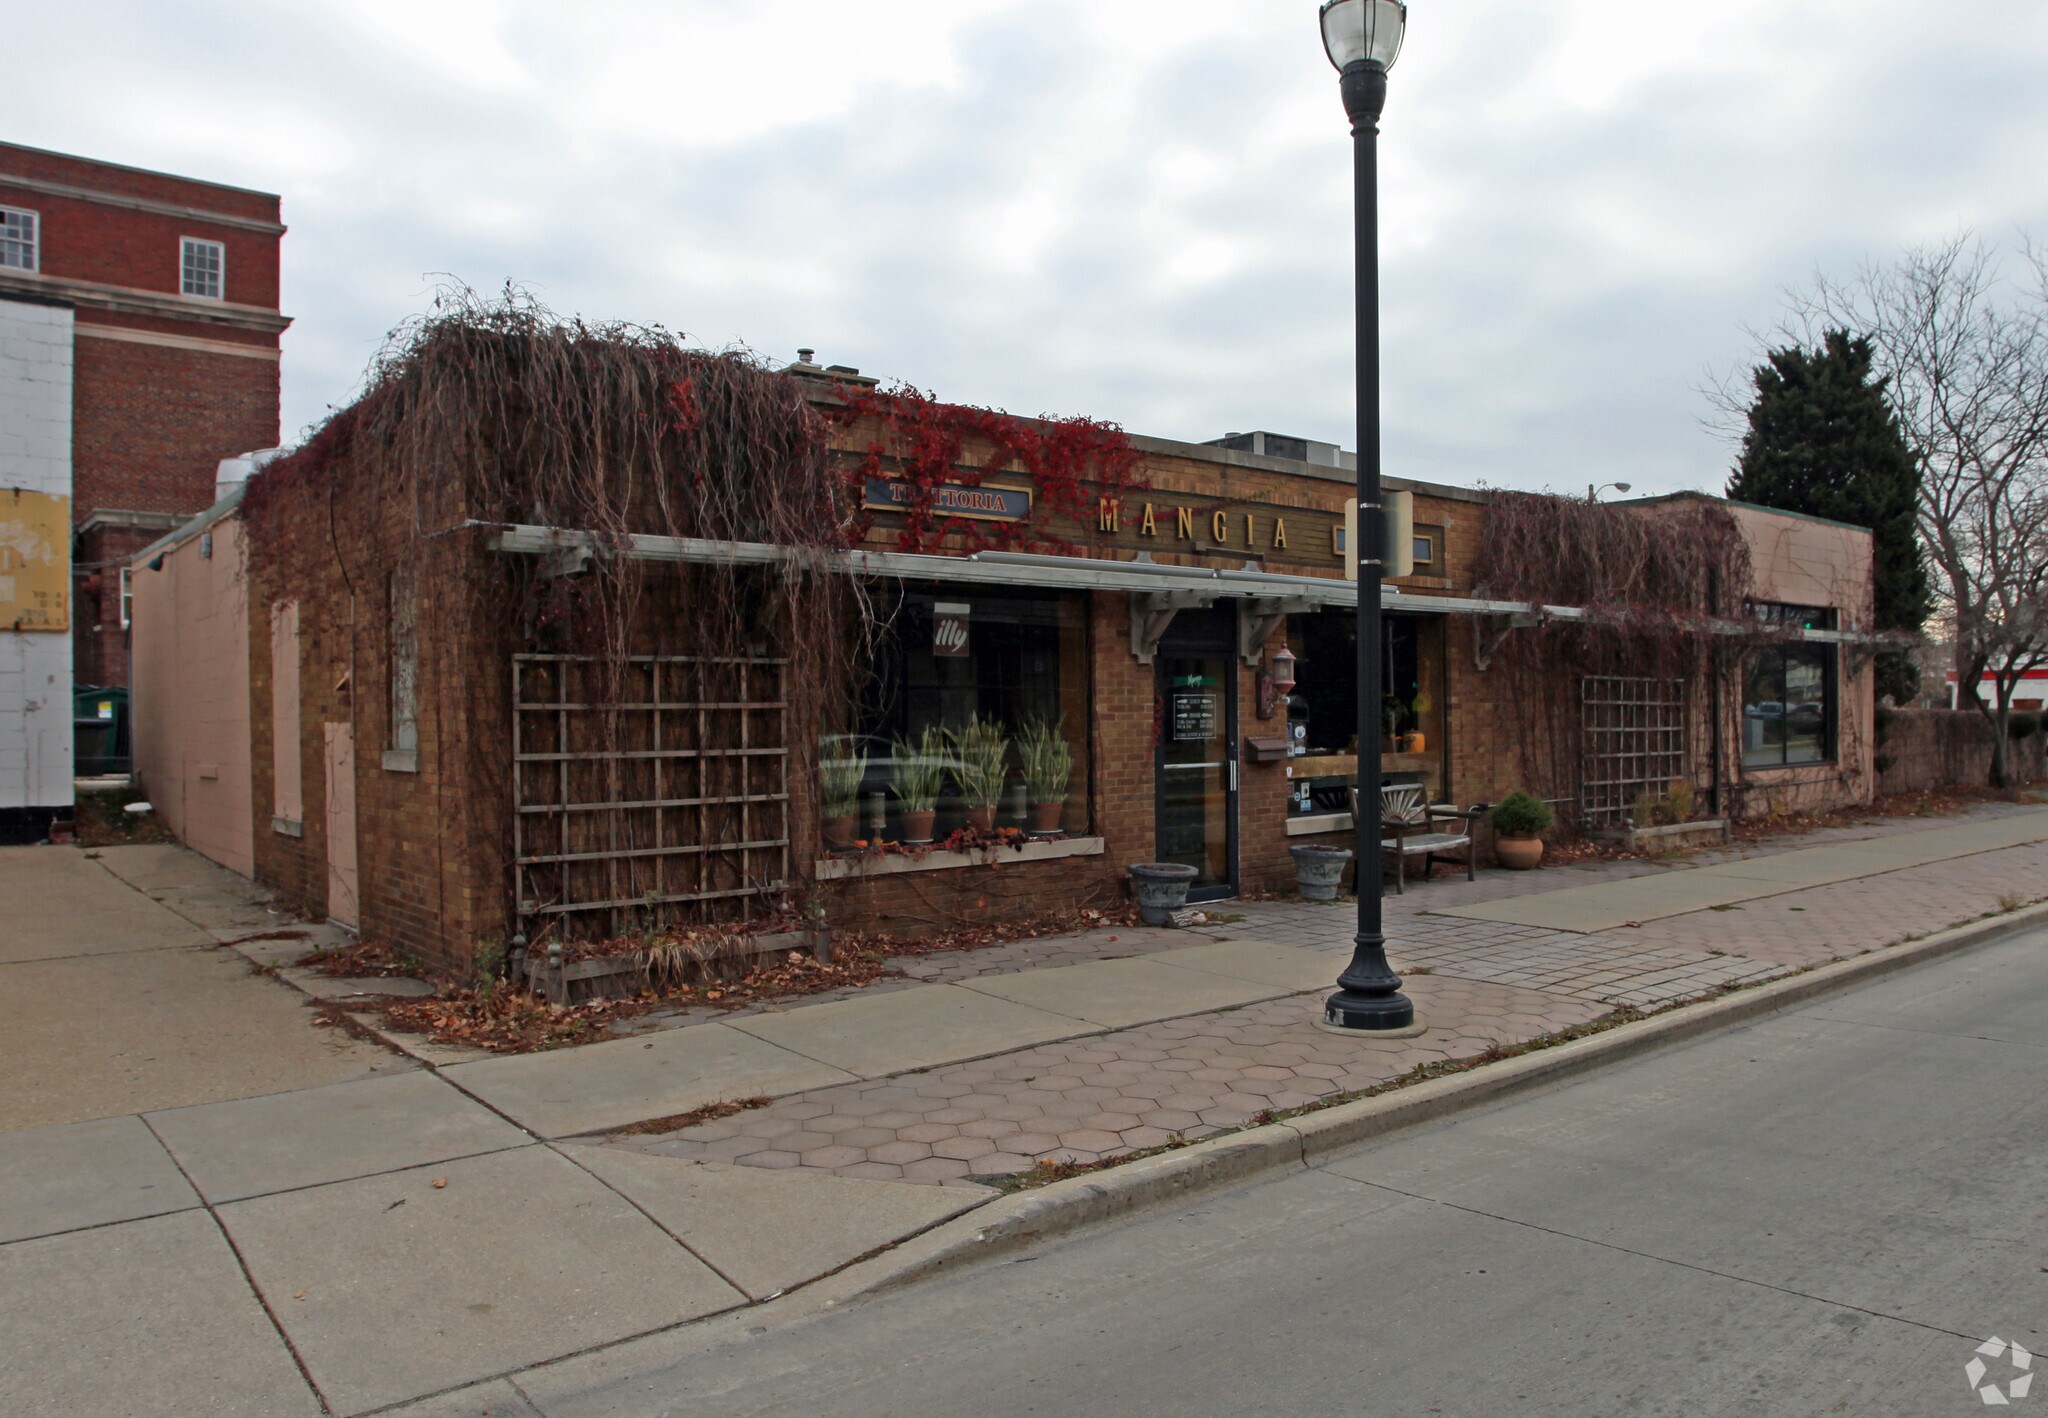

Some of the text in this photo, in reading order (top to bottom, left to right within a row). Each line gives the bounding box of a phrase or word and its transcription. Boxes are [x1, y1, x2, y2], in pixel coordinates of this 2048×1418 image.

[889, 483, 1006, 512] TRTTORIA
[1100, 498, 1287, 548] MANGIA
[935, 619, 967, 652] illy
